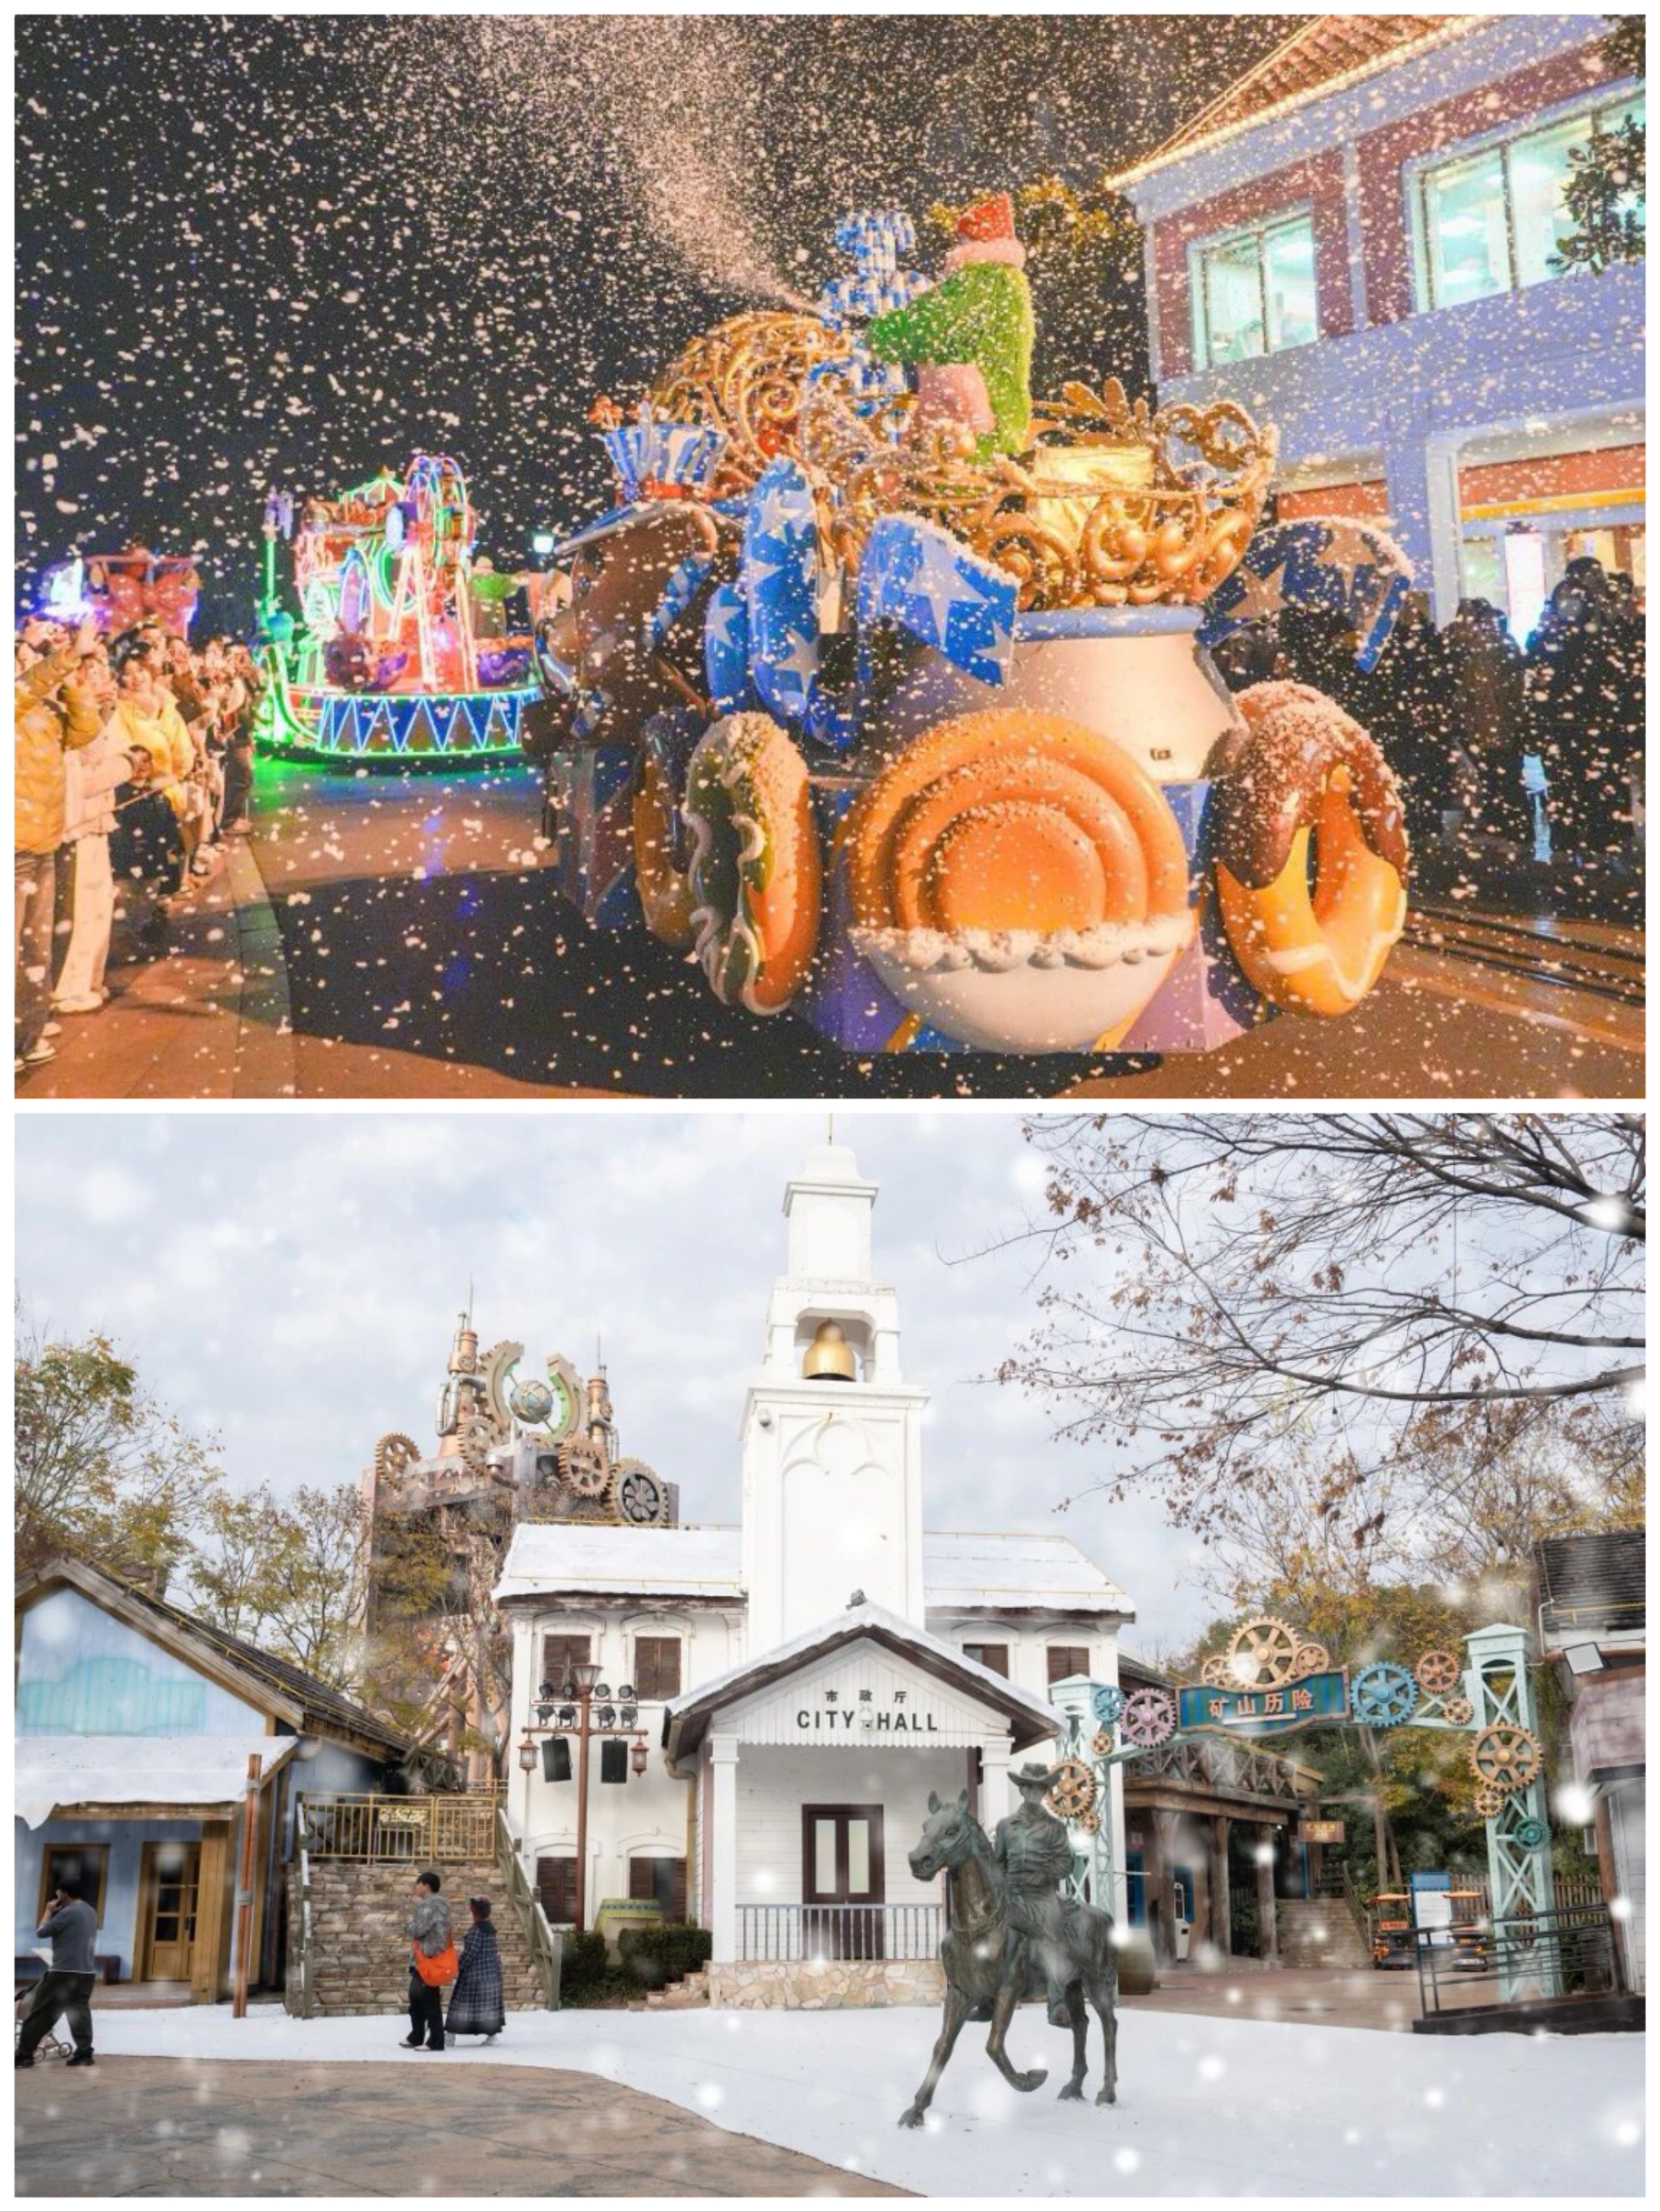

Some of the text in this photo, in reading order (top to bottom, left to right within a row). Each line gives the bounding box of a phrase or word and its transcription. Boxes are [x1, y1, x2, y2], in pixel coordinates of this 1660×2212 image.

[825, 1690, 907, 1704] 市政厅
[1209, 1688, 1314, 1717] 矿山历险
[797, 1710, 938, 1731] CITY HALL
